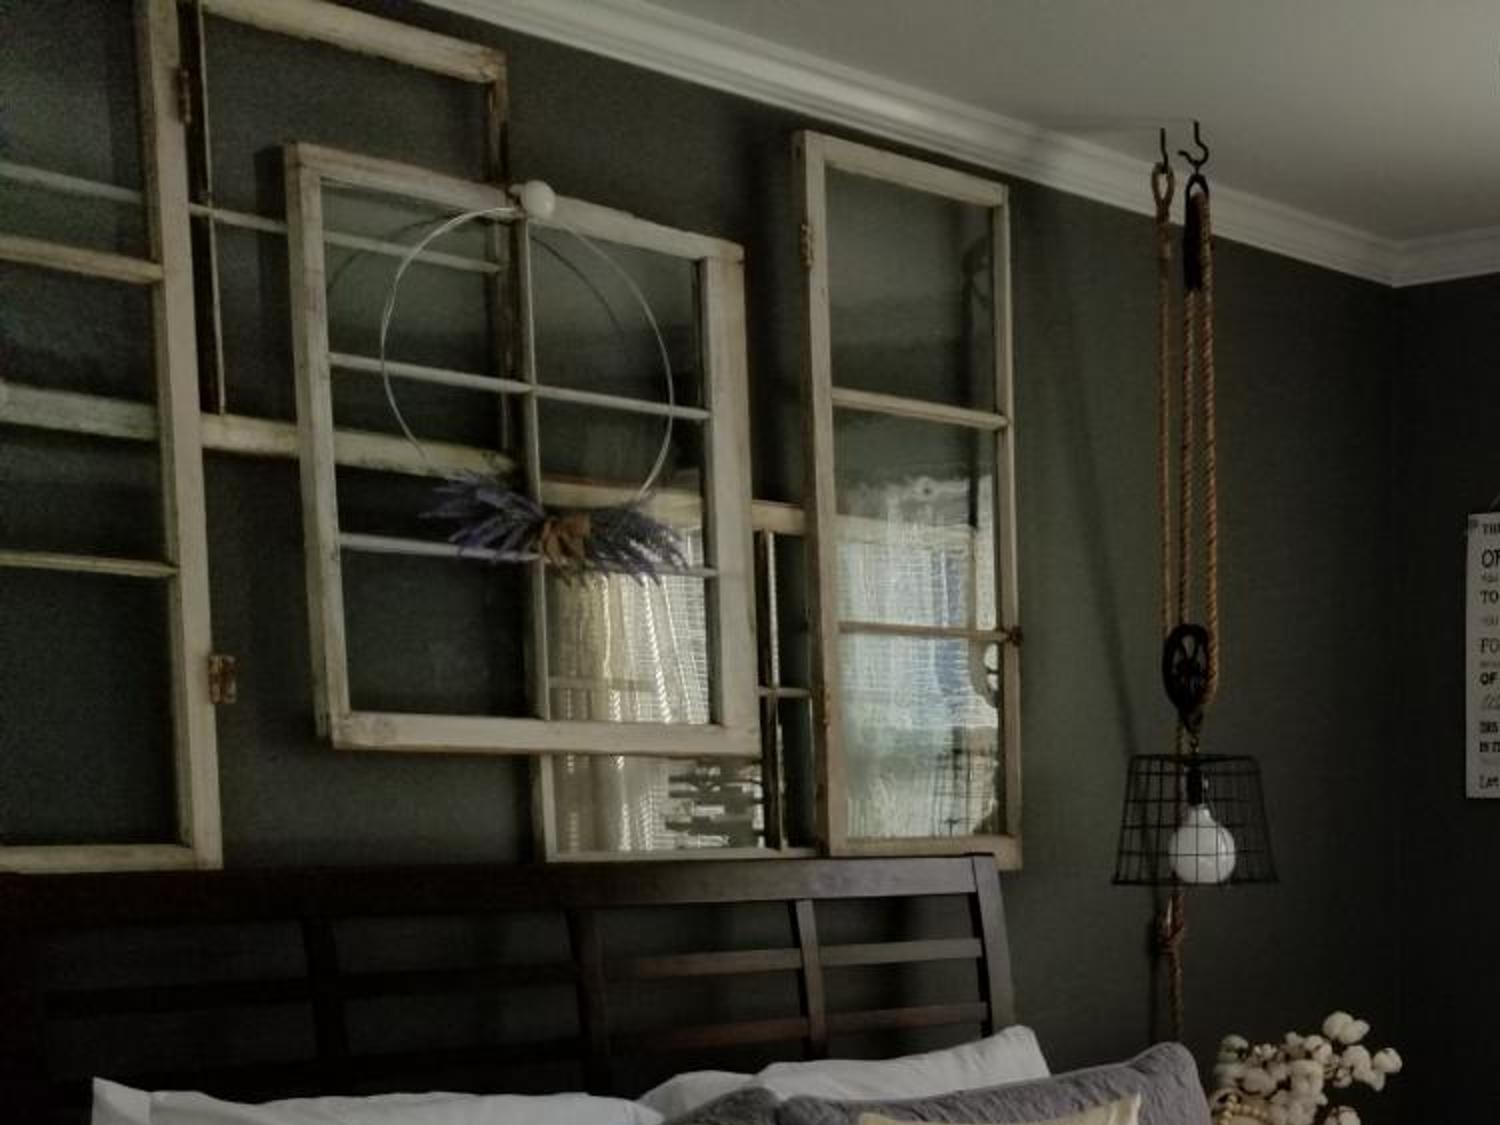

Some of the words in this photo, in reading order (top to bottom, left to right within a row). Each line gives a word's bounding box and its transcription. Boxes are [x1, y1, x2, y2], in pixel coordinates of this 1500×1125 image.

[1480, 589, 1500, 604] TO
[1479, 671, 1498, 685] OF
[1480, 774, 1499, 789] Let
